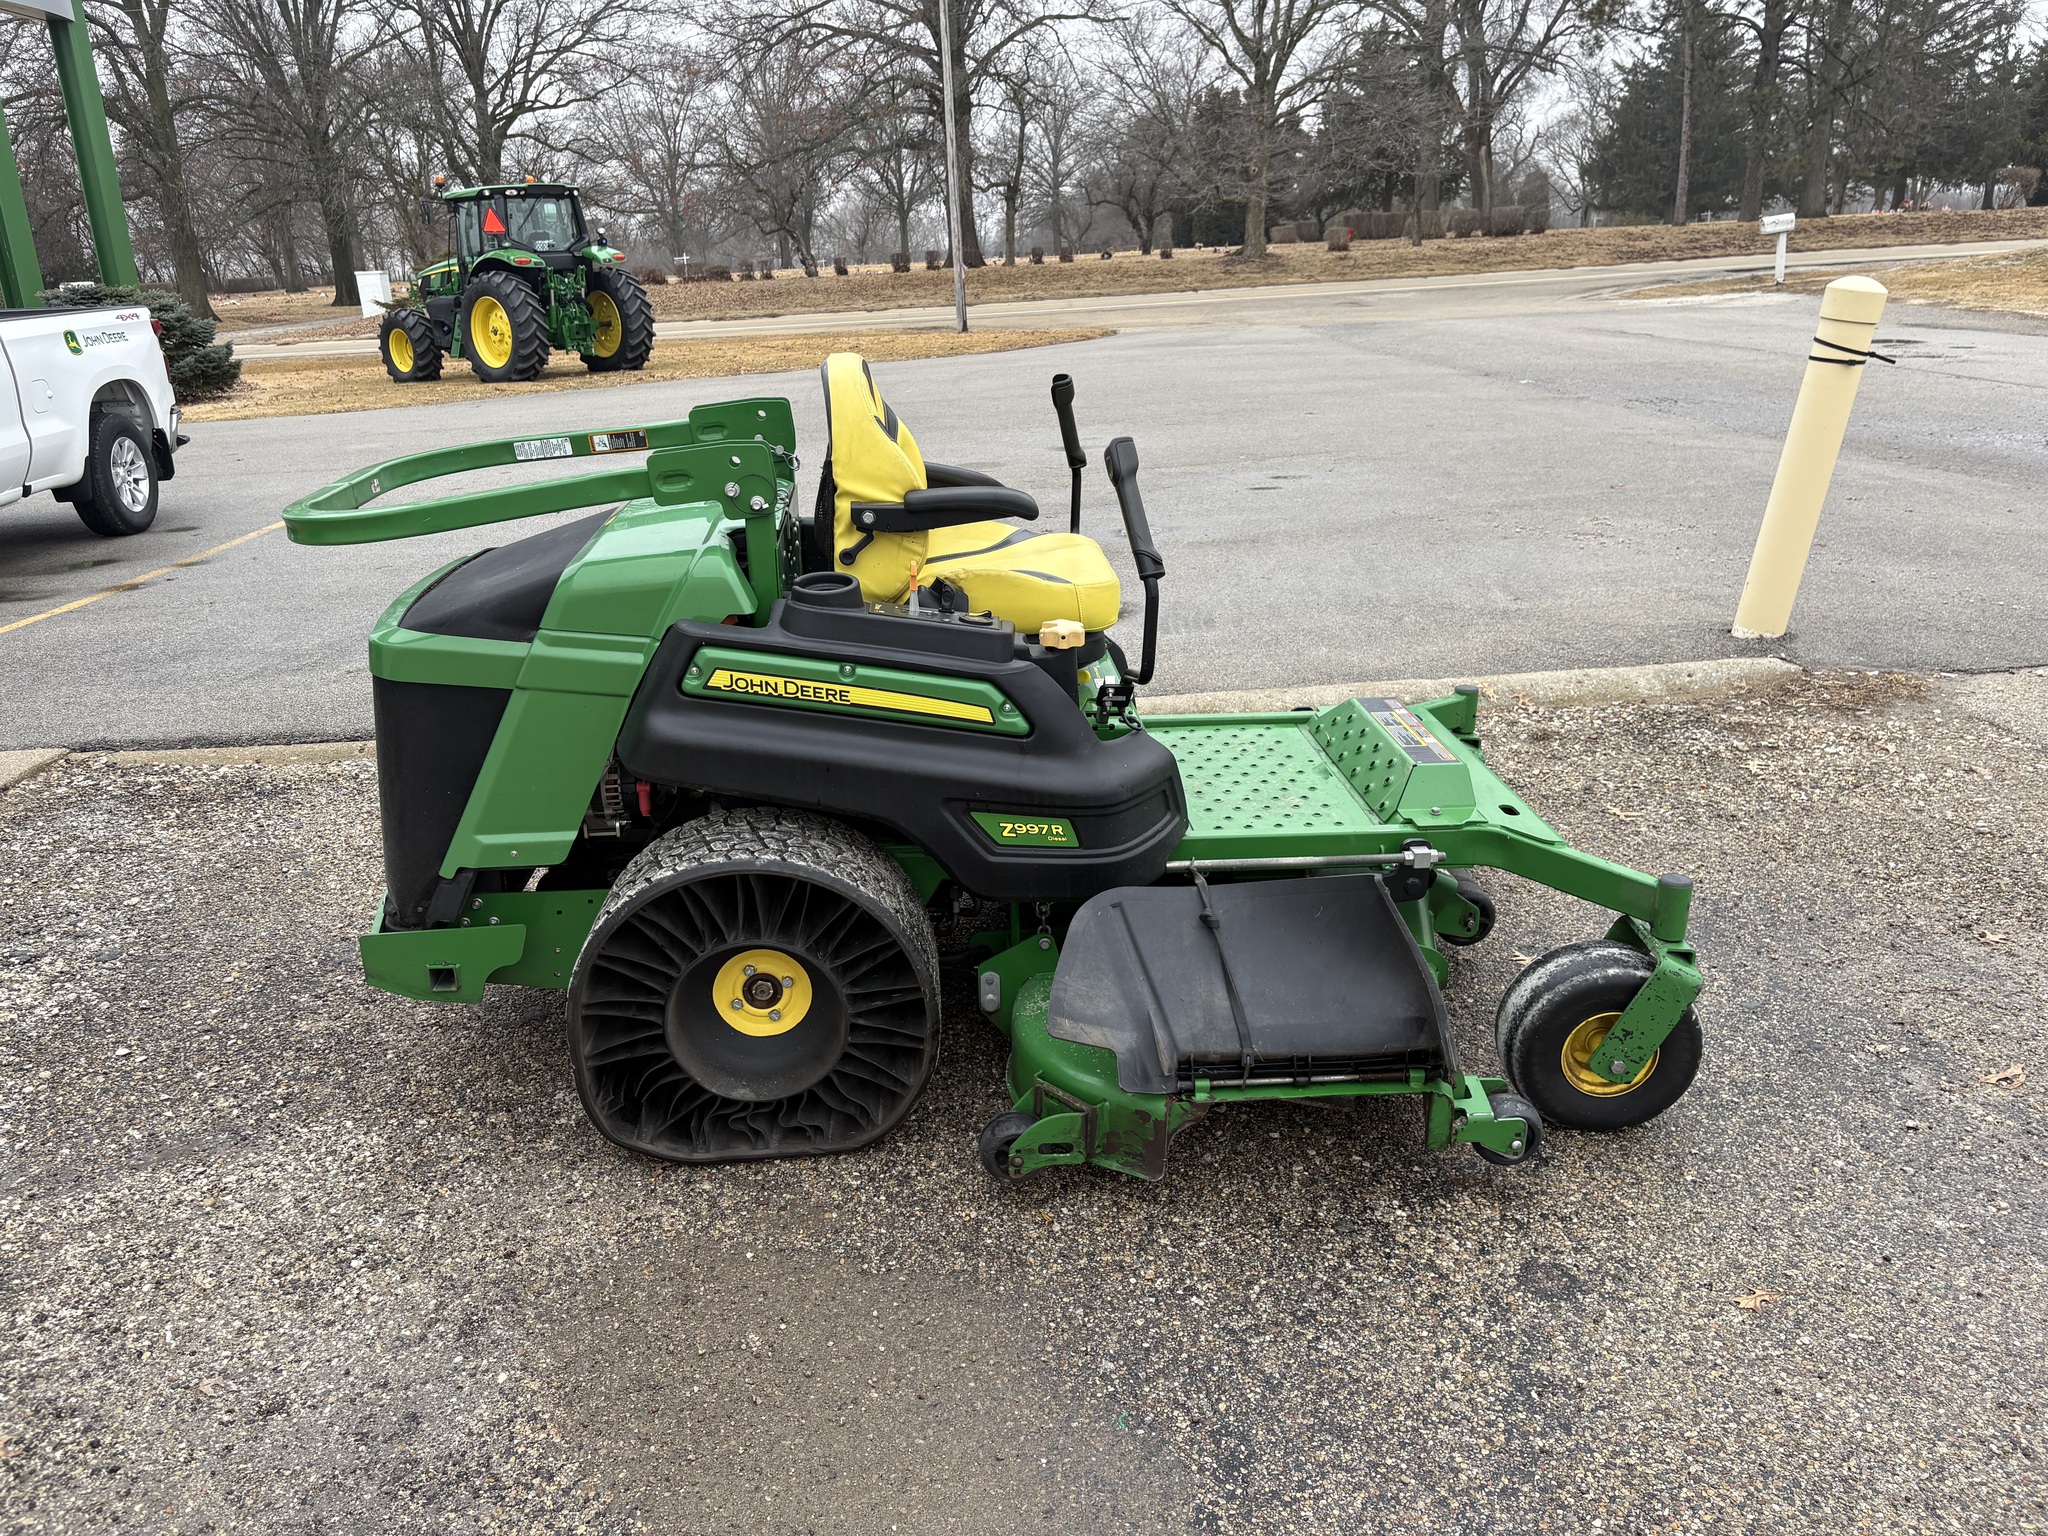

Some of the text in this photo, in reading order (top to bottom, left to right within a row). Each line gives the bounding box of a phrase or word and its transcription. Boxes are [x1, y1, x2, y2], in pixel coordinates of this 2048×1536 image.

[82, 331, 128, 347] JOHN DEERE
[723, 673, 850, 702] JOHN DEERE
